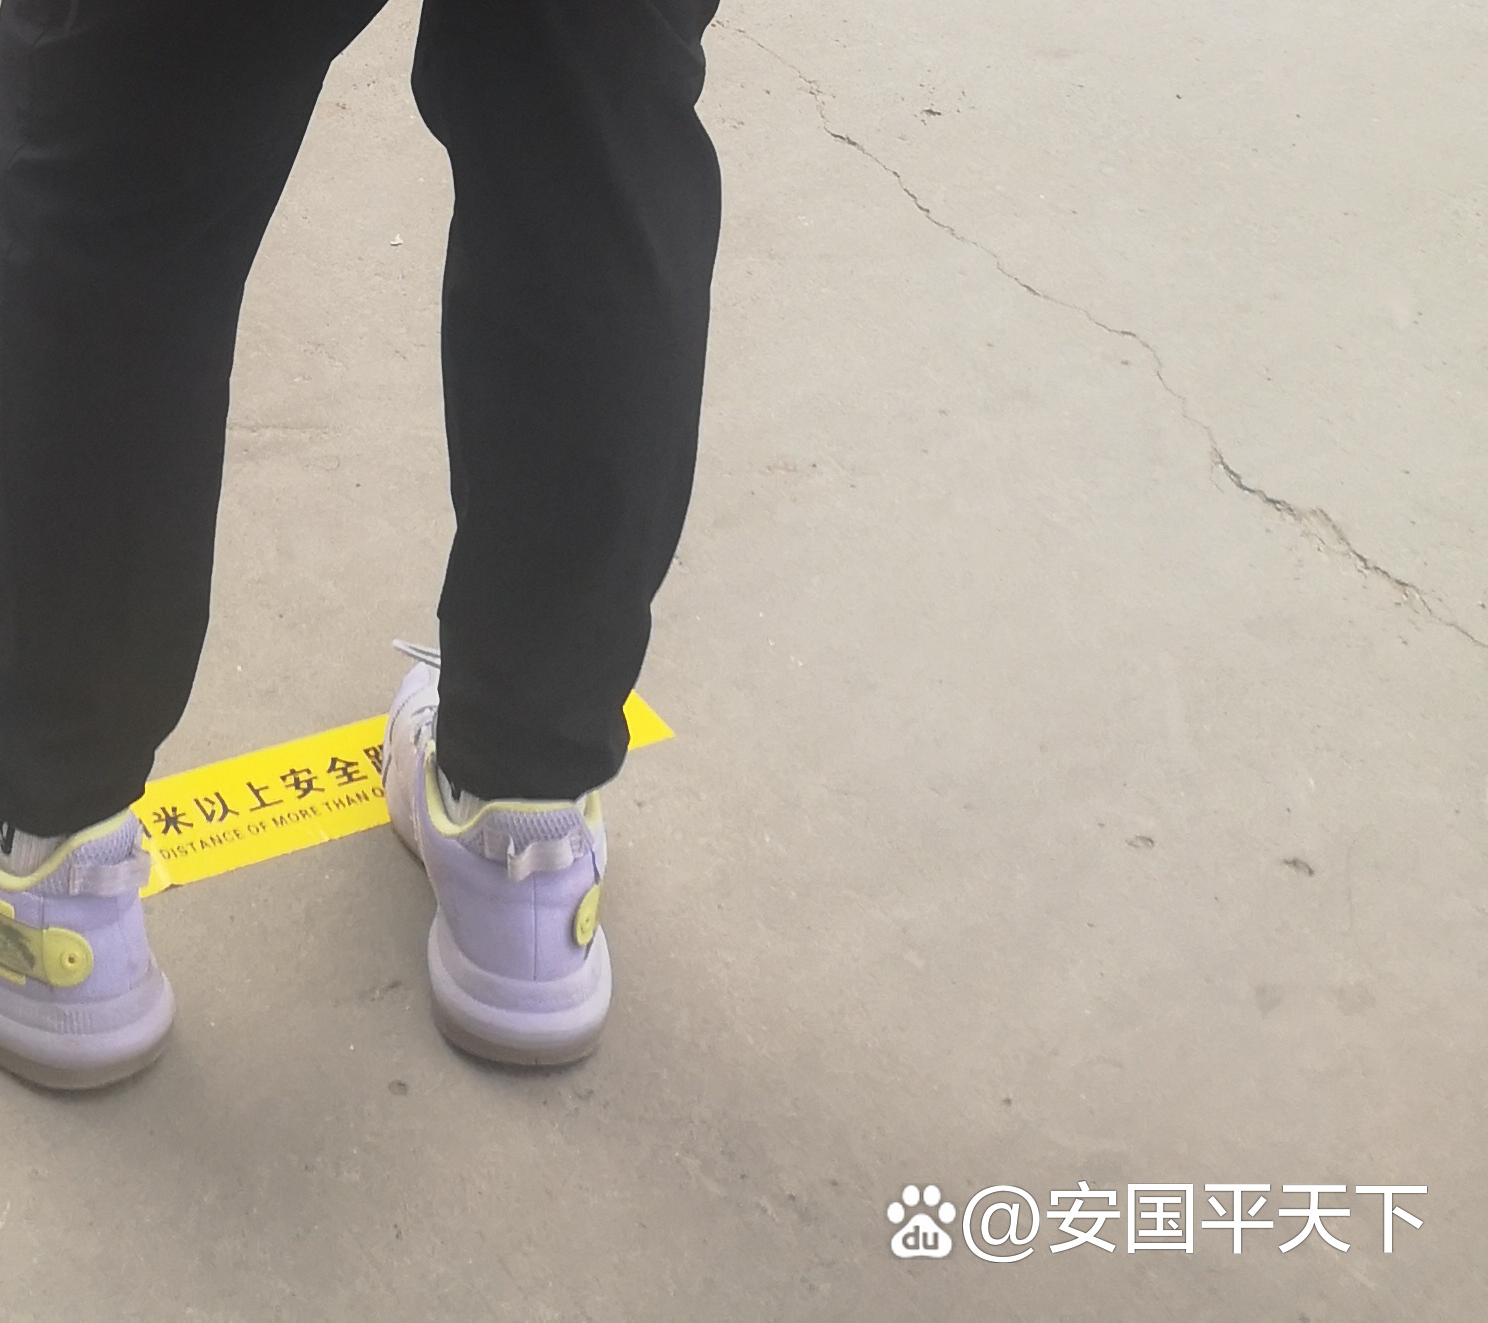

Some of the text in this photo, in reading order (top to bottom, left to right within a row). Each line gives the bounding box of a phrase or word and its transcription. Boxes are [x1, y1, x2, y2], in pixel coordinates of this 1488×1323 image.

[139, 744, 385, 839] 米以上安全
[159, 826, 245, 860] DISTANCE
[249, 820, 267, 836] OF
[273, 805, 319, 830] MORE
[326, 790, 370, 814] THAN
